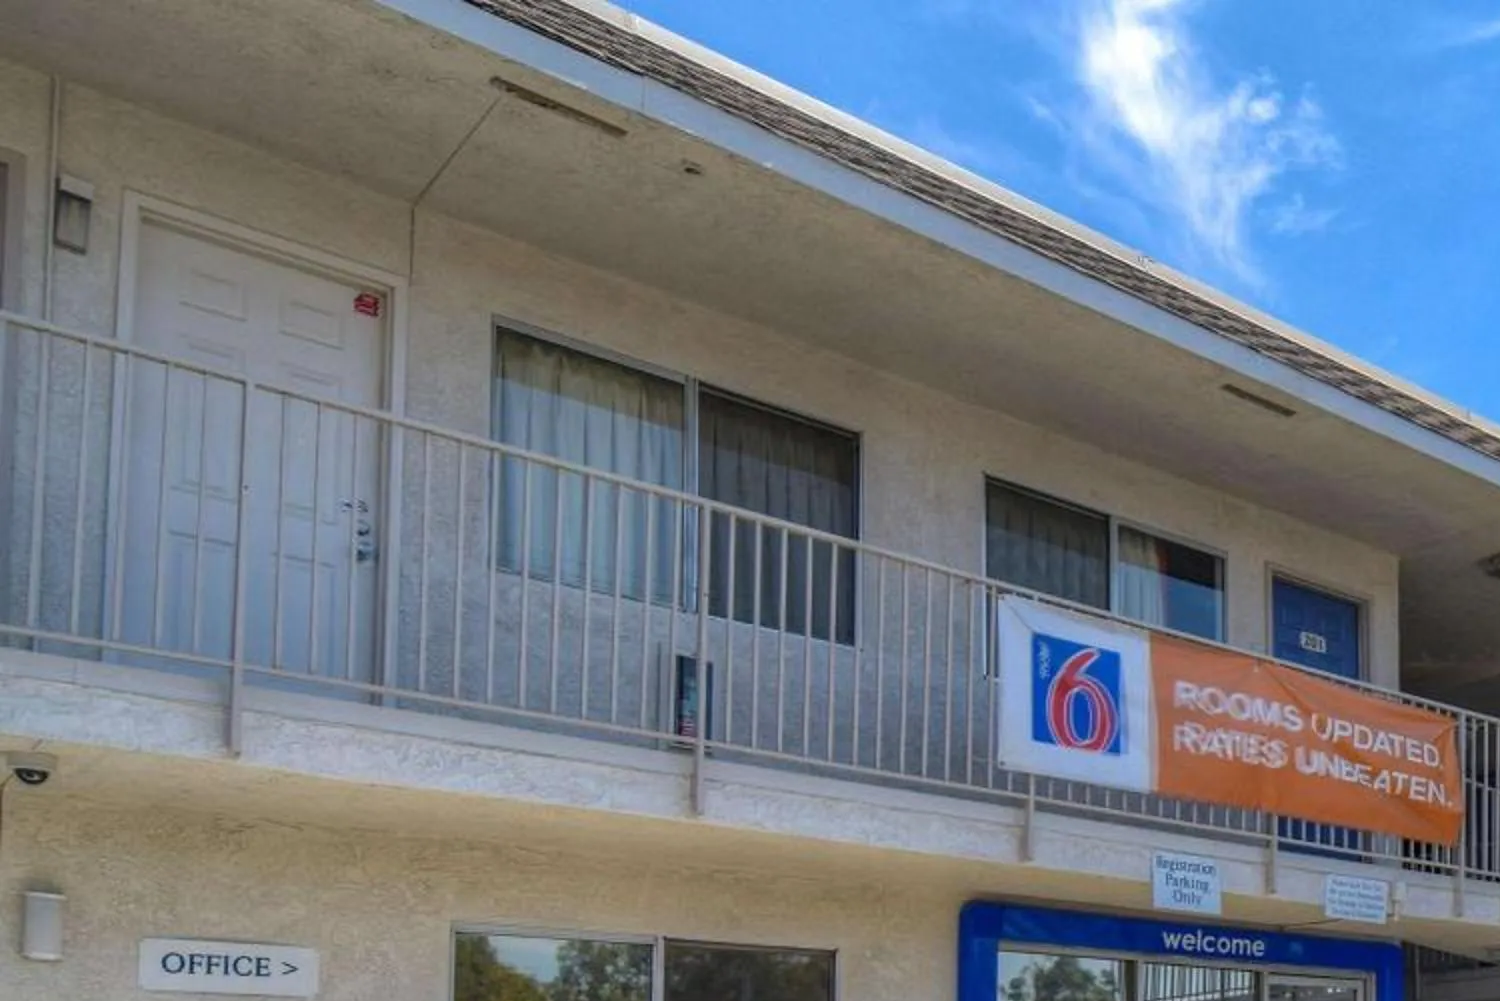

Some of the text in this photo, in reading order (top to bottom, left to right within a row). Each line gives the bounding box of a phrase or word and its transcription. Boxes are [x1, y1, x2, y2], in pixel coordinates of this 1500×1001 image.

[1046, 647, 1119, 754] 6
[1174, 680, 1445, 770] ROOMS UPDATED.
[1173, 721, 1454, 807] RATES UNBEATEN.
[1166, 872, 1209, 895] Parking
[1172, 889, 1203, 909] Only
[1162, 929, 1265, 957] welcome
[161, 952, 272, 977] OFFICE
